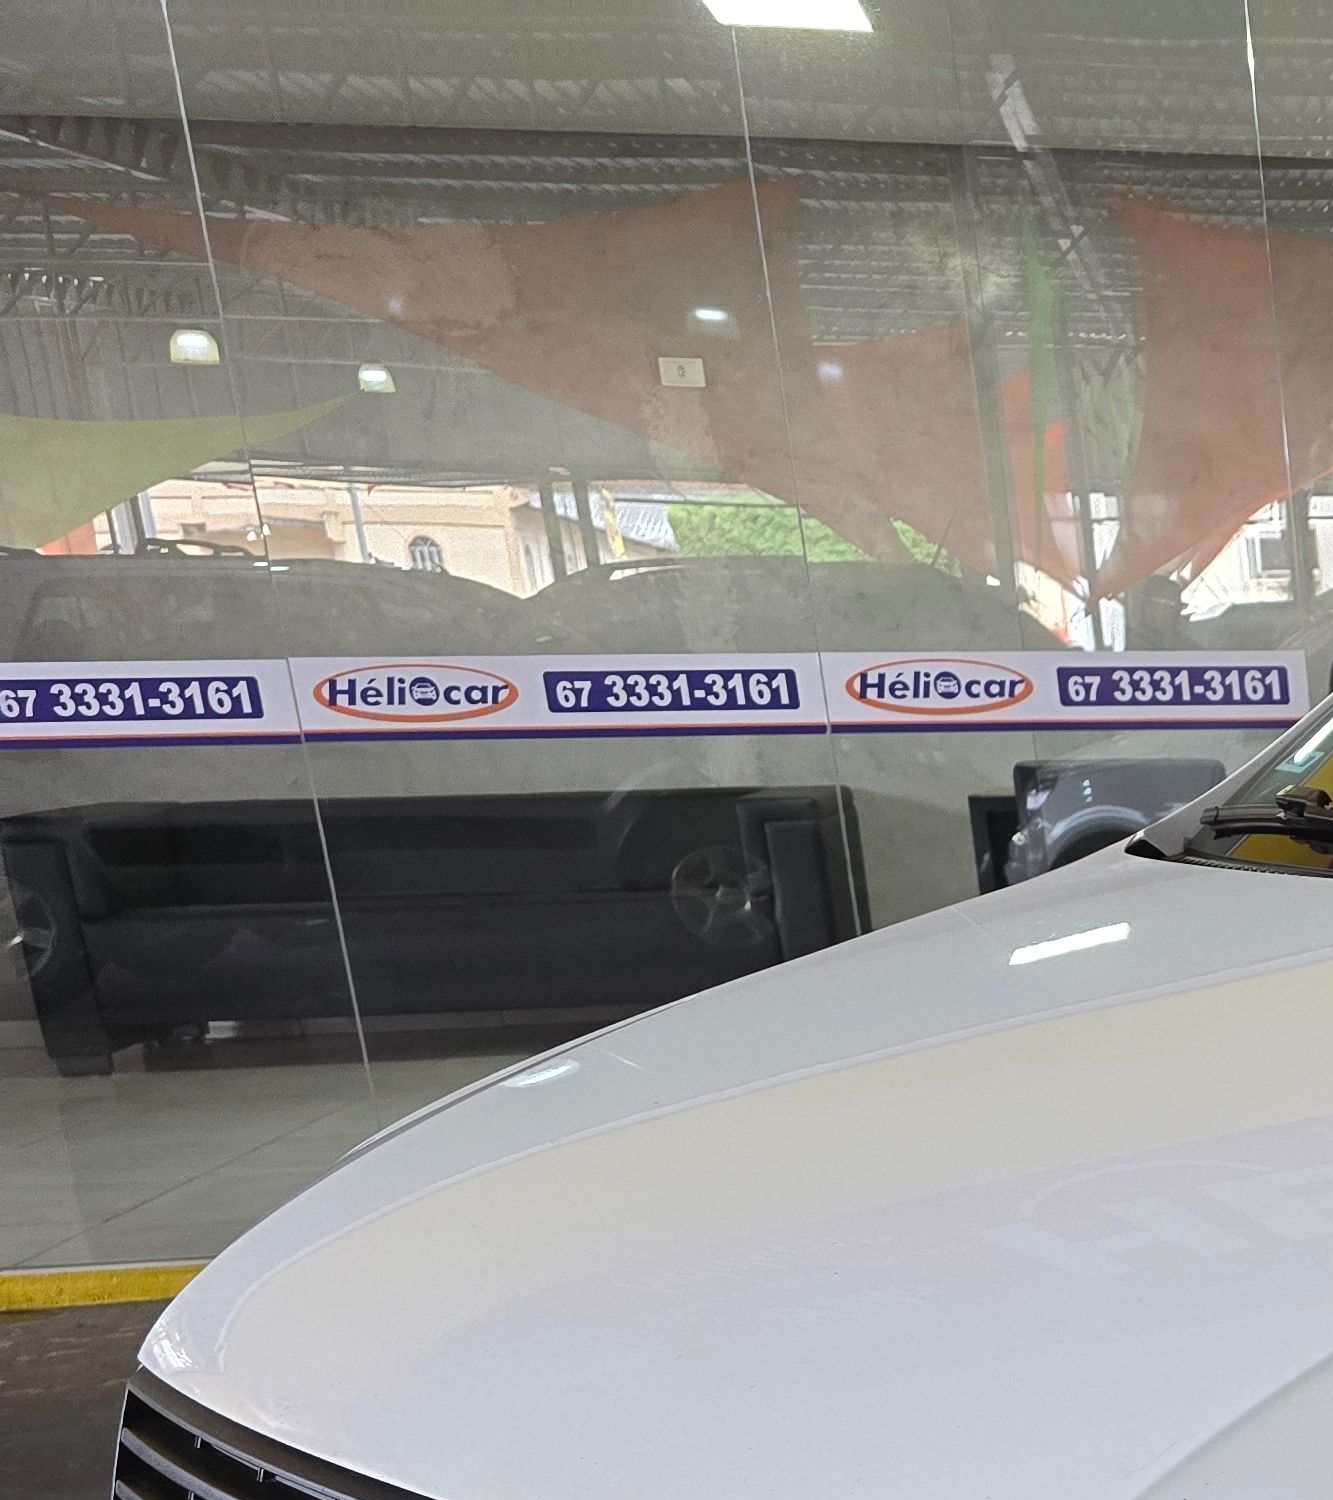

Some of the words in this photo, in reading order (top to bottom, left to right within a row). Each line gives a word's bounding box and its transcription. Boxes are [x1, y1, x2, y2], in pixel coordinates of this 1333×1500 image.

[0, 689, 37, 718] 67
[51, 680, 254, 716] 3331-3161
[555, 680, 592, 709] 67
[606, 671, 791, 707] 3331-3161
[1067, 674, 1101, 703] 67
[1112, 668, 1283, 701] 3331-3161
